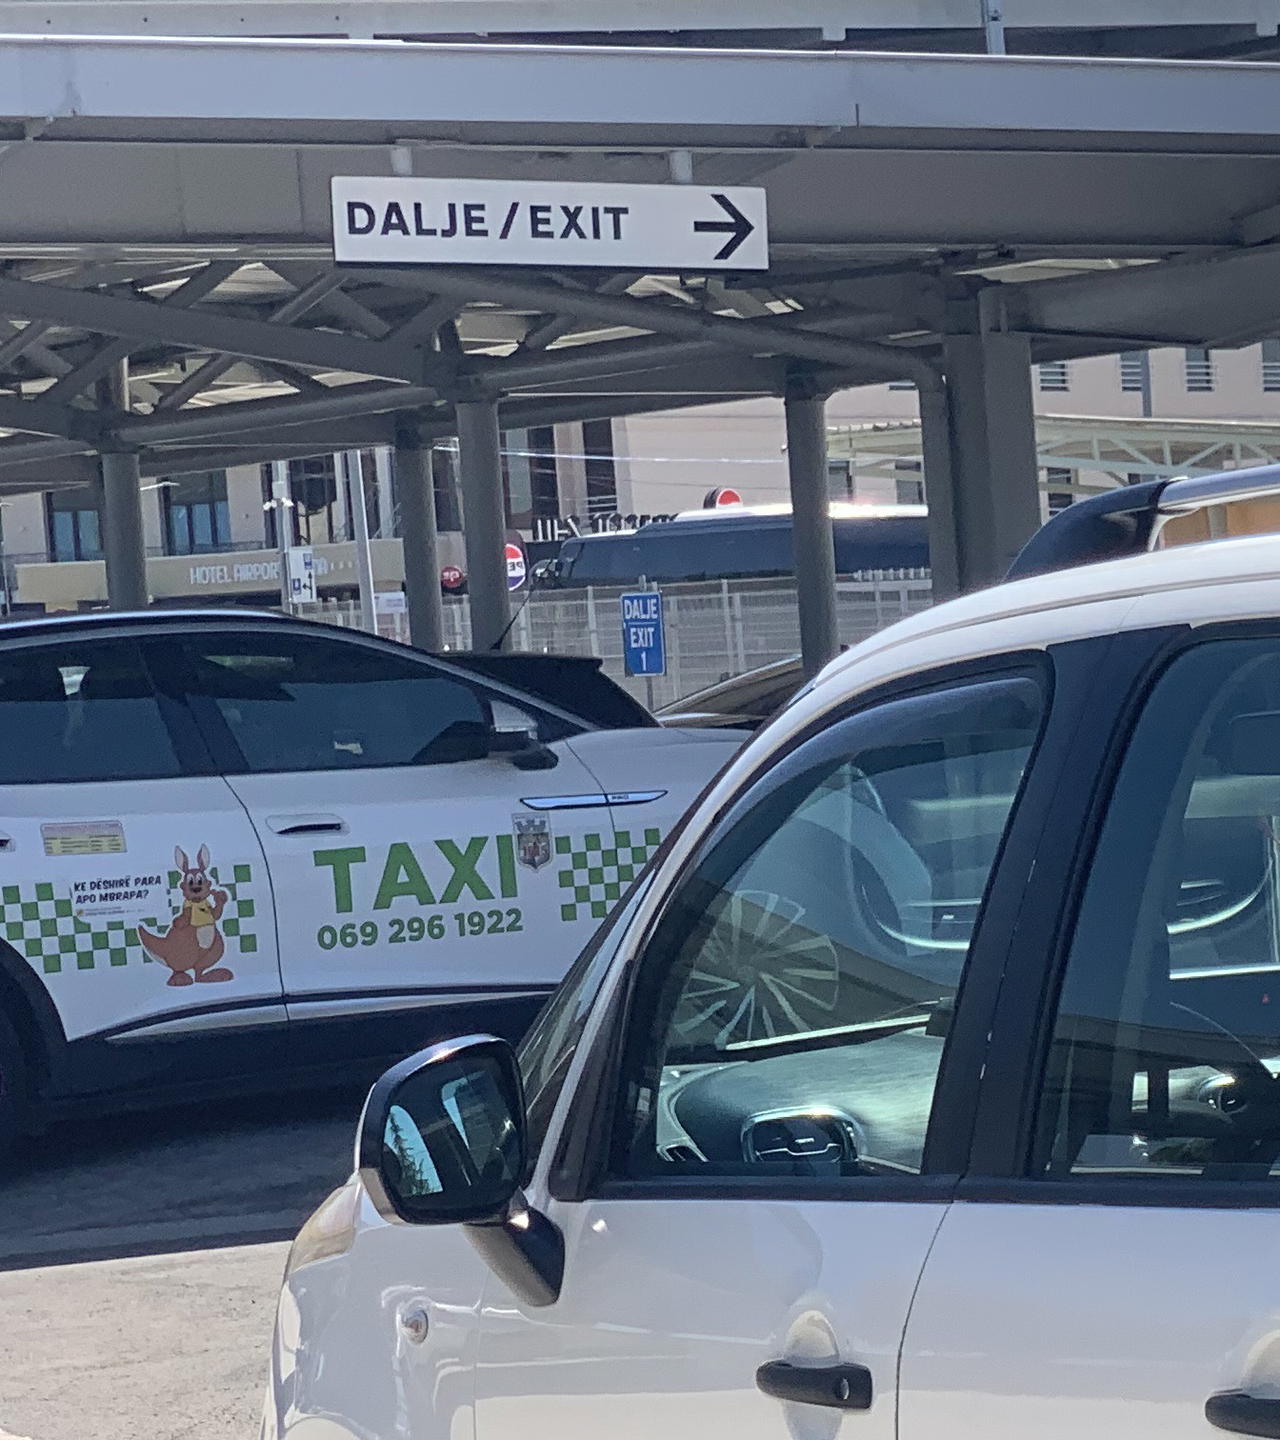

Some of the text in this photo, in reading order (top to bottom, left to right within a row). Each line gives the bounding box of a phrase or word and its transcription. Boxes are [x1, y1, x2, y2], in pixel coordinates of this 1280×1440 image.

[190, 562, 282, 584] HOTEL AIRPOR
[624, 599, 658, 619] DALJE
[630, 627, 655, 648] EXIT
[641, 650, 647, 671] 1
[134, 875, 162, 887] PARA
[313, 834, 518, 913] TAXI
[76, 889, 149, 904] APO MBRAPA?
[317, 908, 523, 950] 069 296 1922
